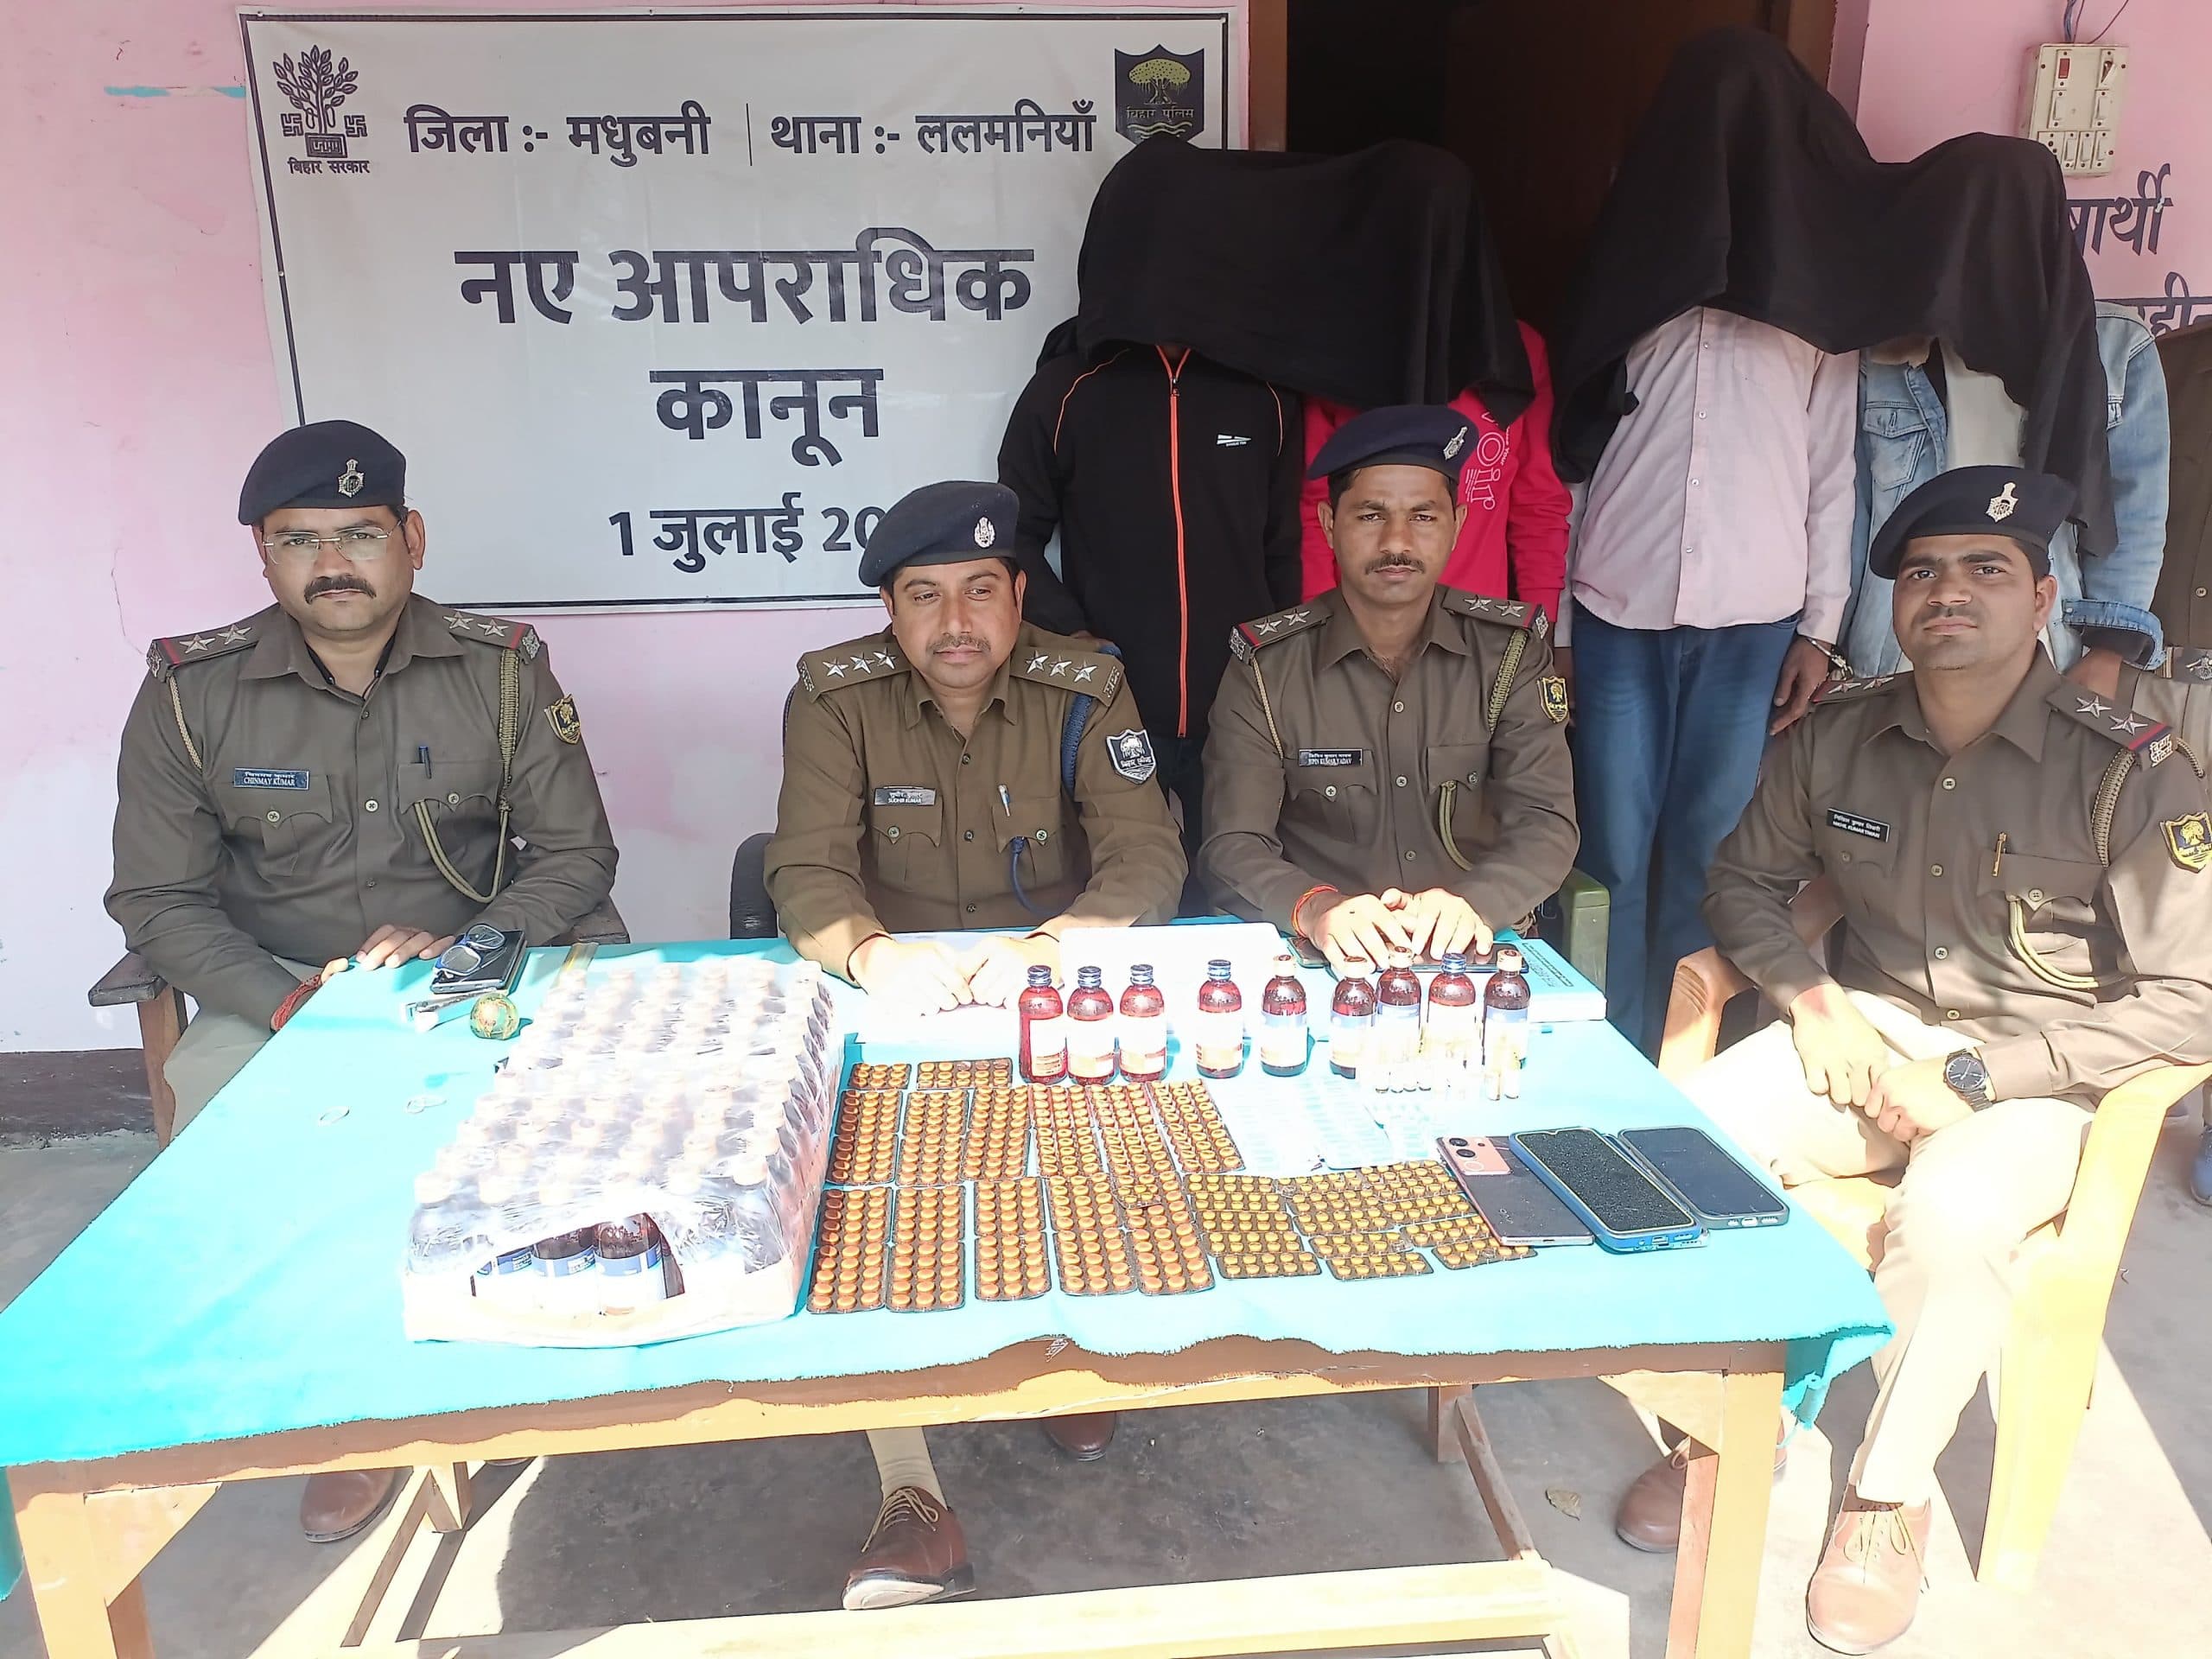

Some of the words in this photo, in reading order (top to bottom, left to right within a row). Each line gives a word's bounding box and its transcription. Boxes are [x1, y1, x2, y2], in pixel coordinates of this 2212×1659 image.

[404, 104, 509, 154] जिला
[566, 99, 711, 168] मधुबनी
[771, 116, 861, 154] थाना
[914, 98, 1096, 154] ललमनियाँ
[288, 156, 322, 175] बिहार
[327, 159, 371, 175] सरकार
[454, 251, 579, 325] नए
[607, 227, 1035, 325] आपराधिक
[649, 368, 884, 467] कानून
[609, 512, 634, 556] 1
[650, 492, 804, 573] जुलाई
[243, 777, 273, 785] CHINMAY
[273, 777, 296, 786] KUMAR
